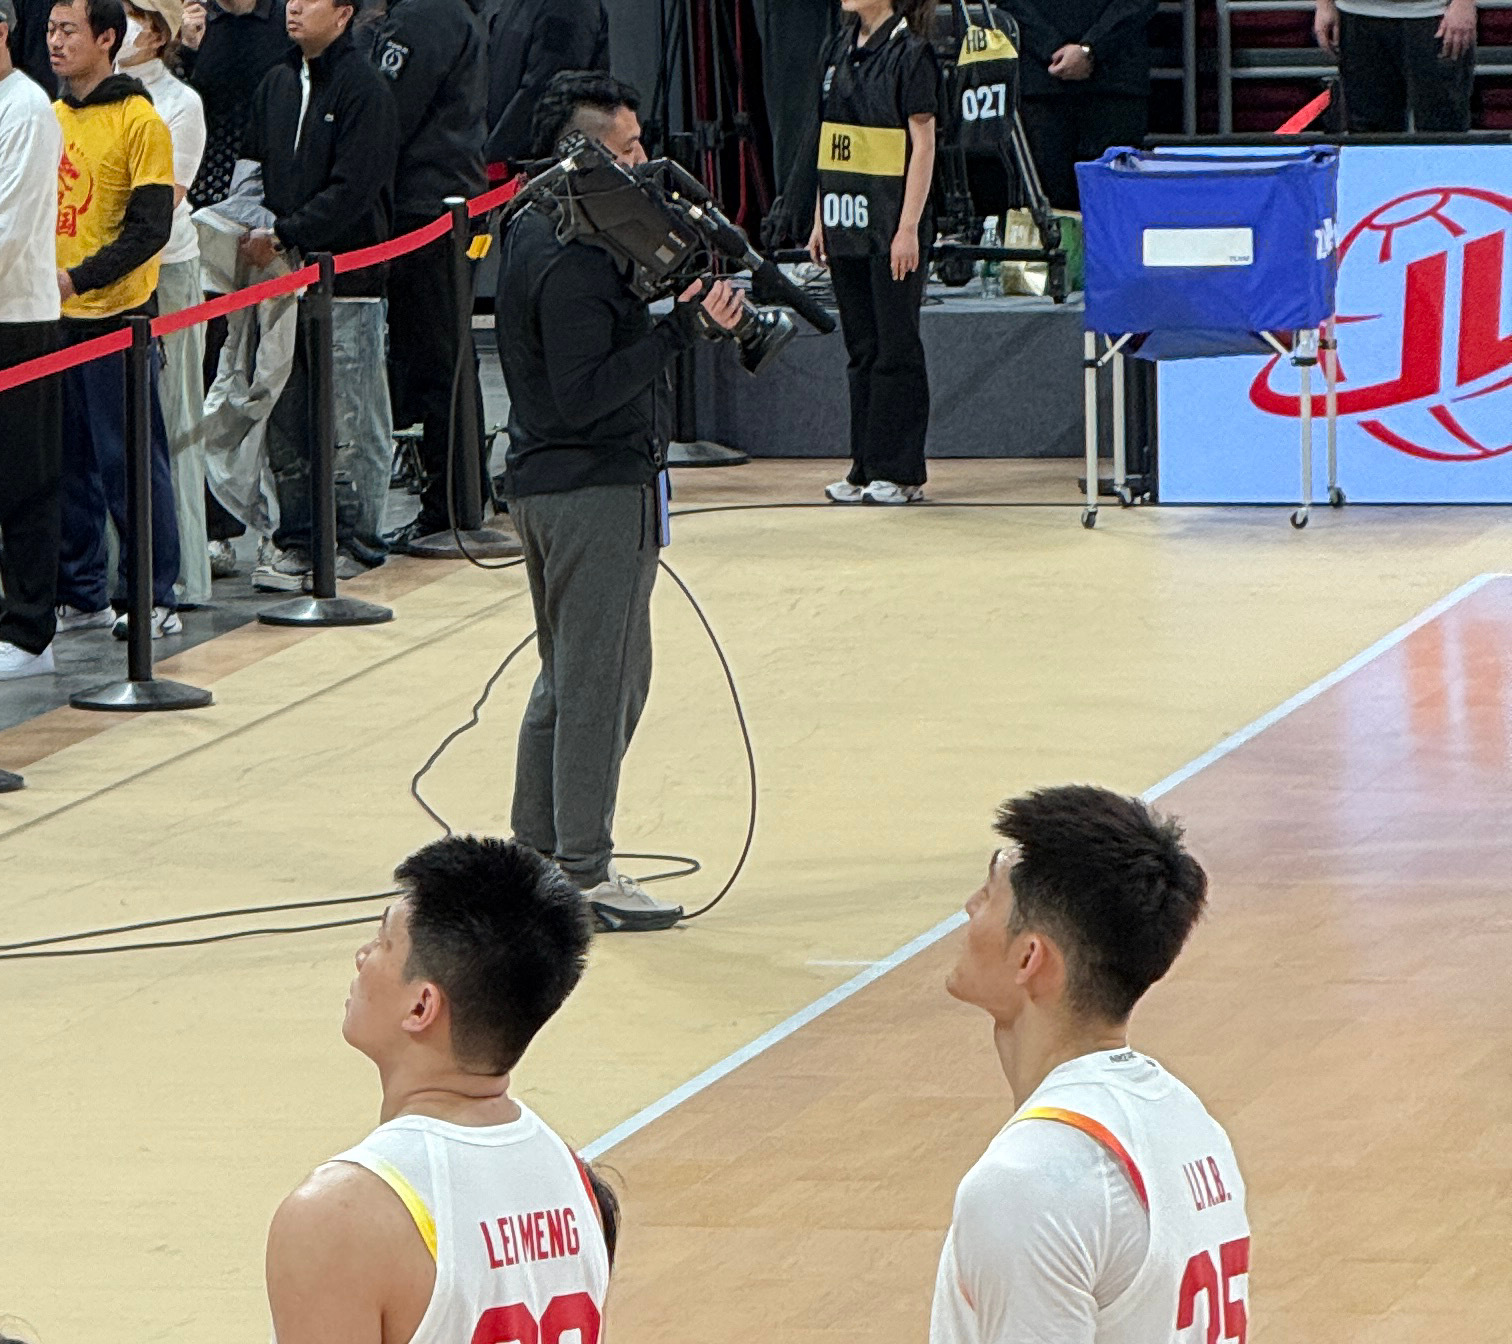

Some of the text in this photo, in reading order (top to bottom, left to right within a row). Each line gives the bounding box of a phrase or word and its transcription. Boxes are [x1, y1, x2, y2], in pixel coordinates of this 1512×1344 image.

[966, 26, 988, 54] HB
[962, 83, 1006, 121] 027
[832, 133, 851, 161] HB
[823, 193, 868, 227] 006
[480, 1206, 580, 1270] LEI MENG
